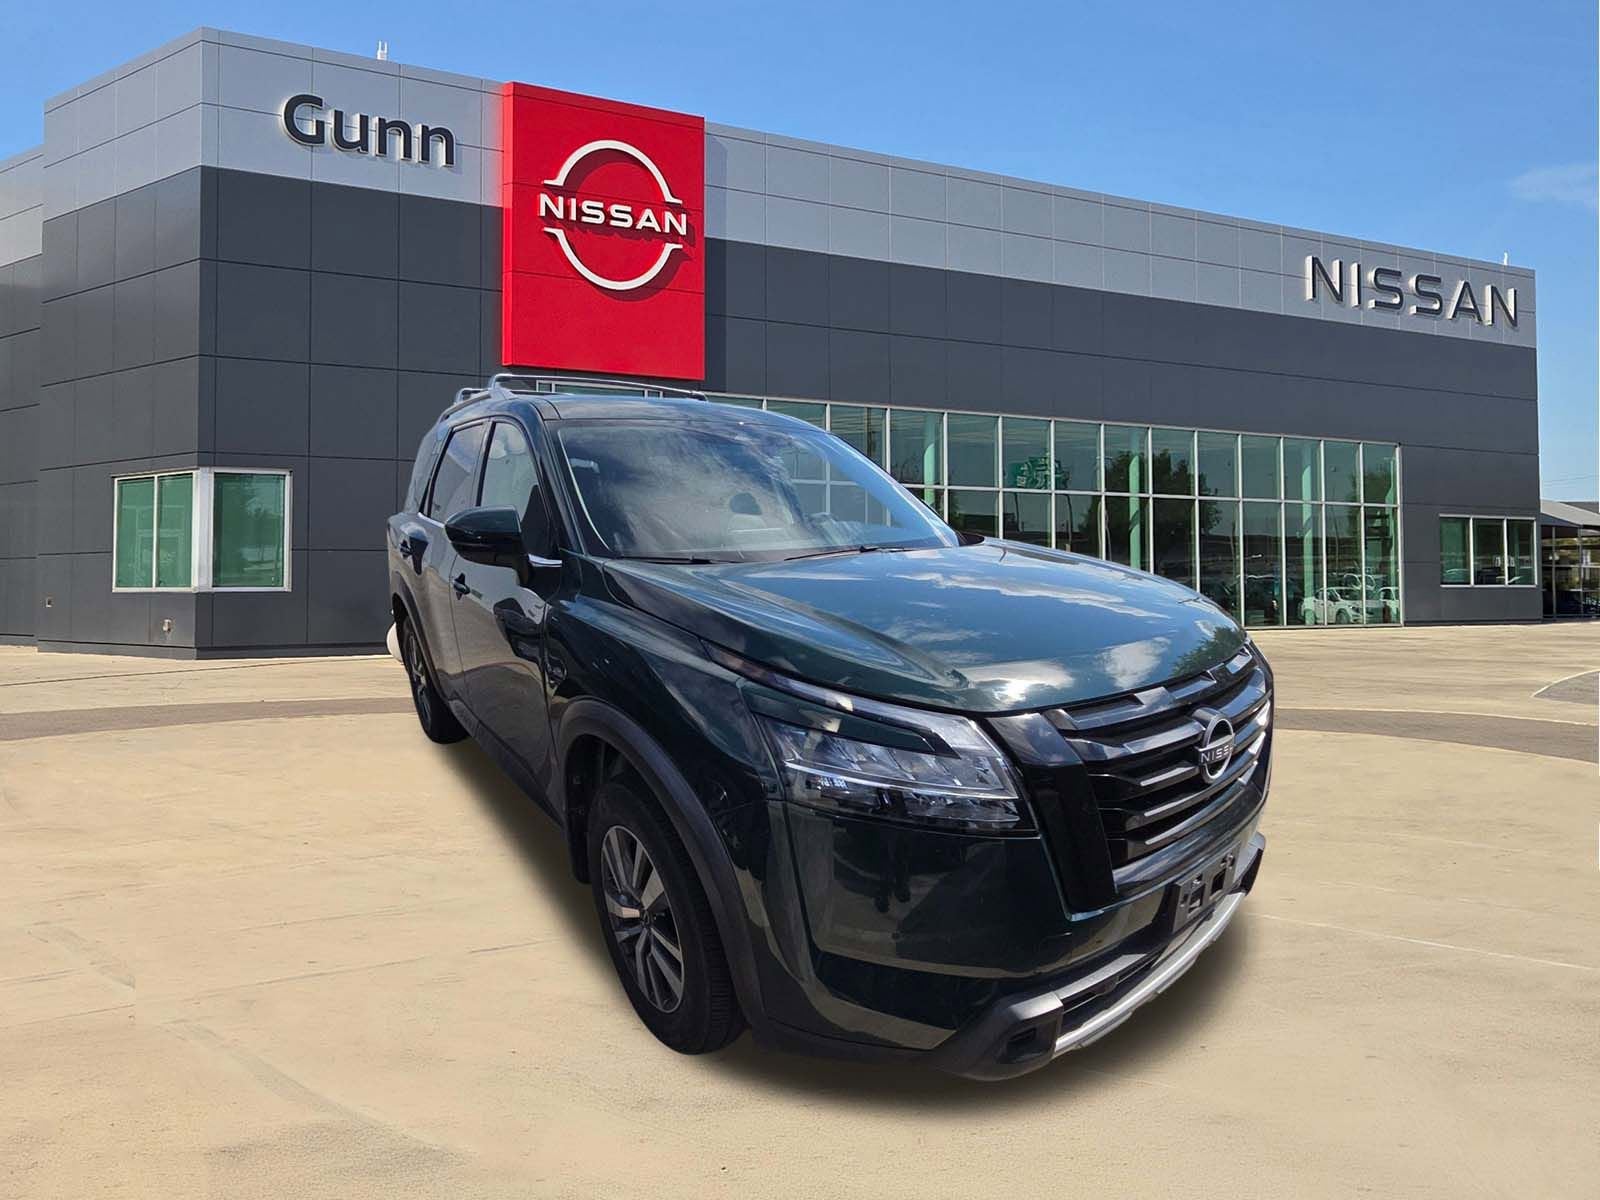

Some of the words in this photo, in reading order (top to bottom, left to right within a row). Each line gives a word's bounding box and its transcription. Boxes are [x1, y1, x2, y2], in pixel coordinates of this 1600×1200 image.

[283, 94, 456, 168] Gunn
[539, 193, 688, 235] NISSAN
[1305, 255, 1519, 328] NISSAN
[1201, 745, 1233, 763] NISS
